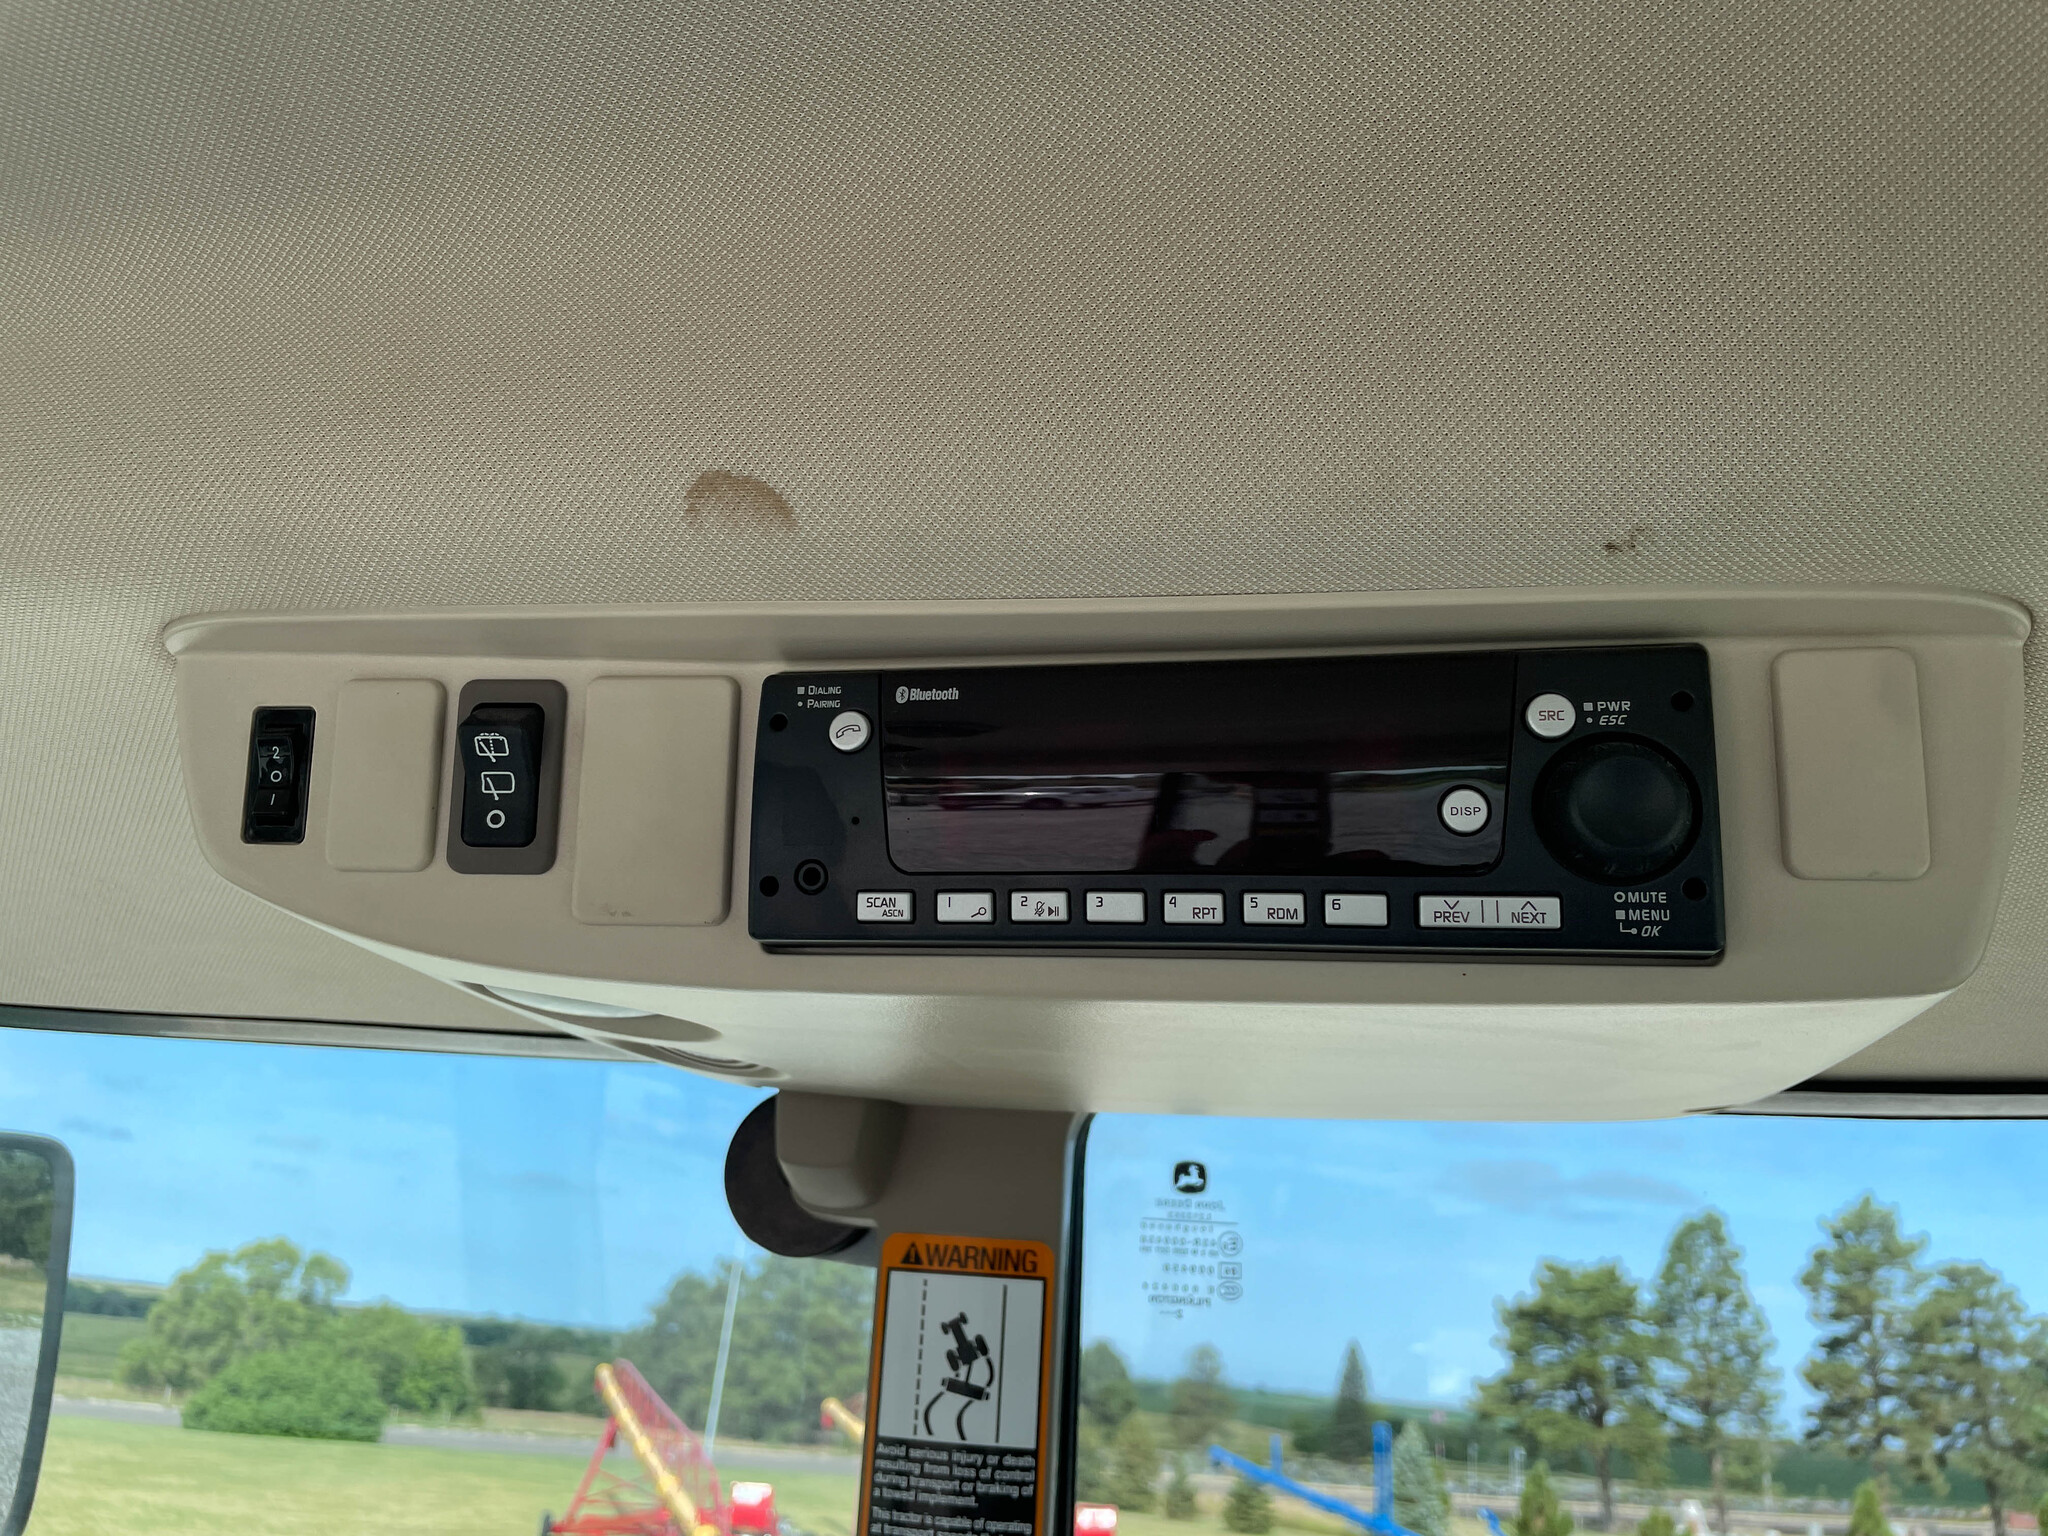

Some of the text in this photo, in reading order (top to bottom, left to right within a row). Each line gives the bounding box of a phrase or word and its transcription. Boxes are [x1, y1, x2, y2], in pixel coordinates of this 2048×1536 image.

[909, 687, 959, 701] Bluetooth
[1597, 700, 1631, 712] PWR
[1538, 709, 1565, 722] SRC
[1598, 714, 1628, 726] ESC
[271, 745, 281, 760] 2
[1449, 805, 1482, 818] DISP
[865, 896, 897, 909] SCAN
[1019, 895, 1029, 908] 2
[1094, 896, 1104, 908] 3
[1168, 896, 1178, 908] 4
[1249, 896, 1259, 909] 5
[1627, 891, 1667, 903] MUTE
[1331, 898, 1342, 911] 6
[881, 908, 905, 918] ASCN
[1191, 906, 1218, 921] RPT
[1266, 907, 1299, 921] RDM
[1432, 909, 1471, 924] PREV
[1510, 910, 1548, 925] NEXT
[1628, 909, 1671, 921] MENU
[1640, 925, 1663, 937] OK
[926, 1243, 1039, 1273] WARNING
[877, 1443, 1036, 1467] Avoid serious injury or death
[923, 1462, 950, 1475] from
[978, 1467, 993, 1479] of
[873, 1472, 908, 1488] during
[961, 1481, 975, 1492] or
[1021, 1484, 1034, 1497] of
